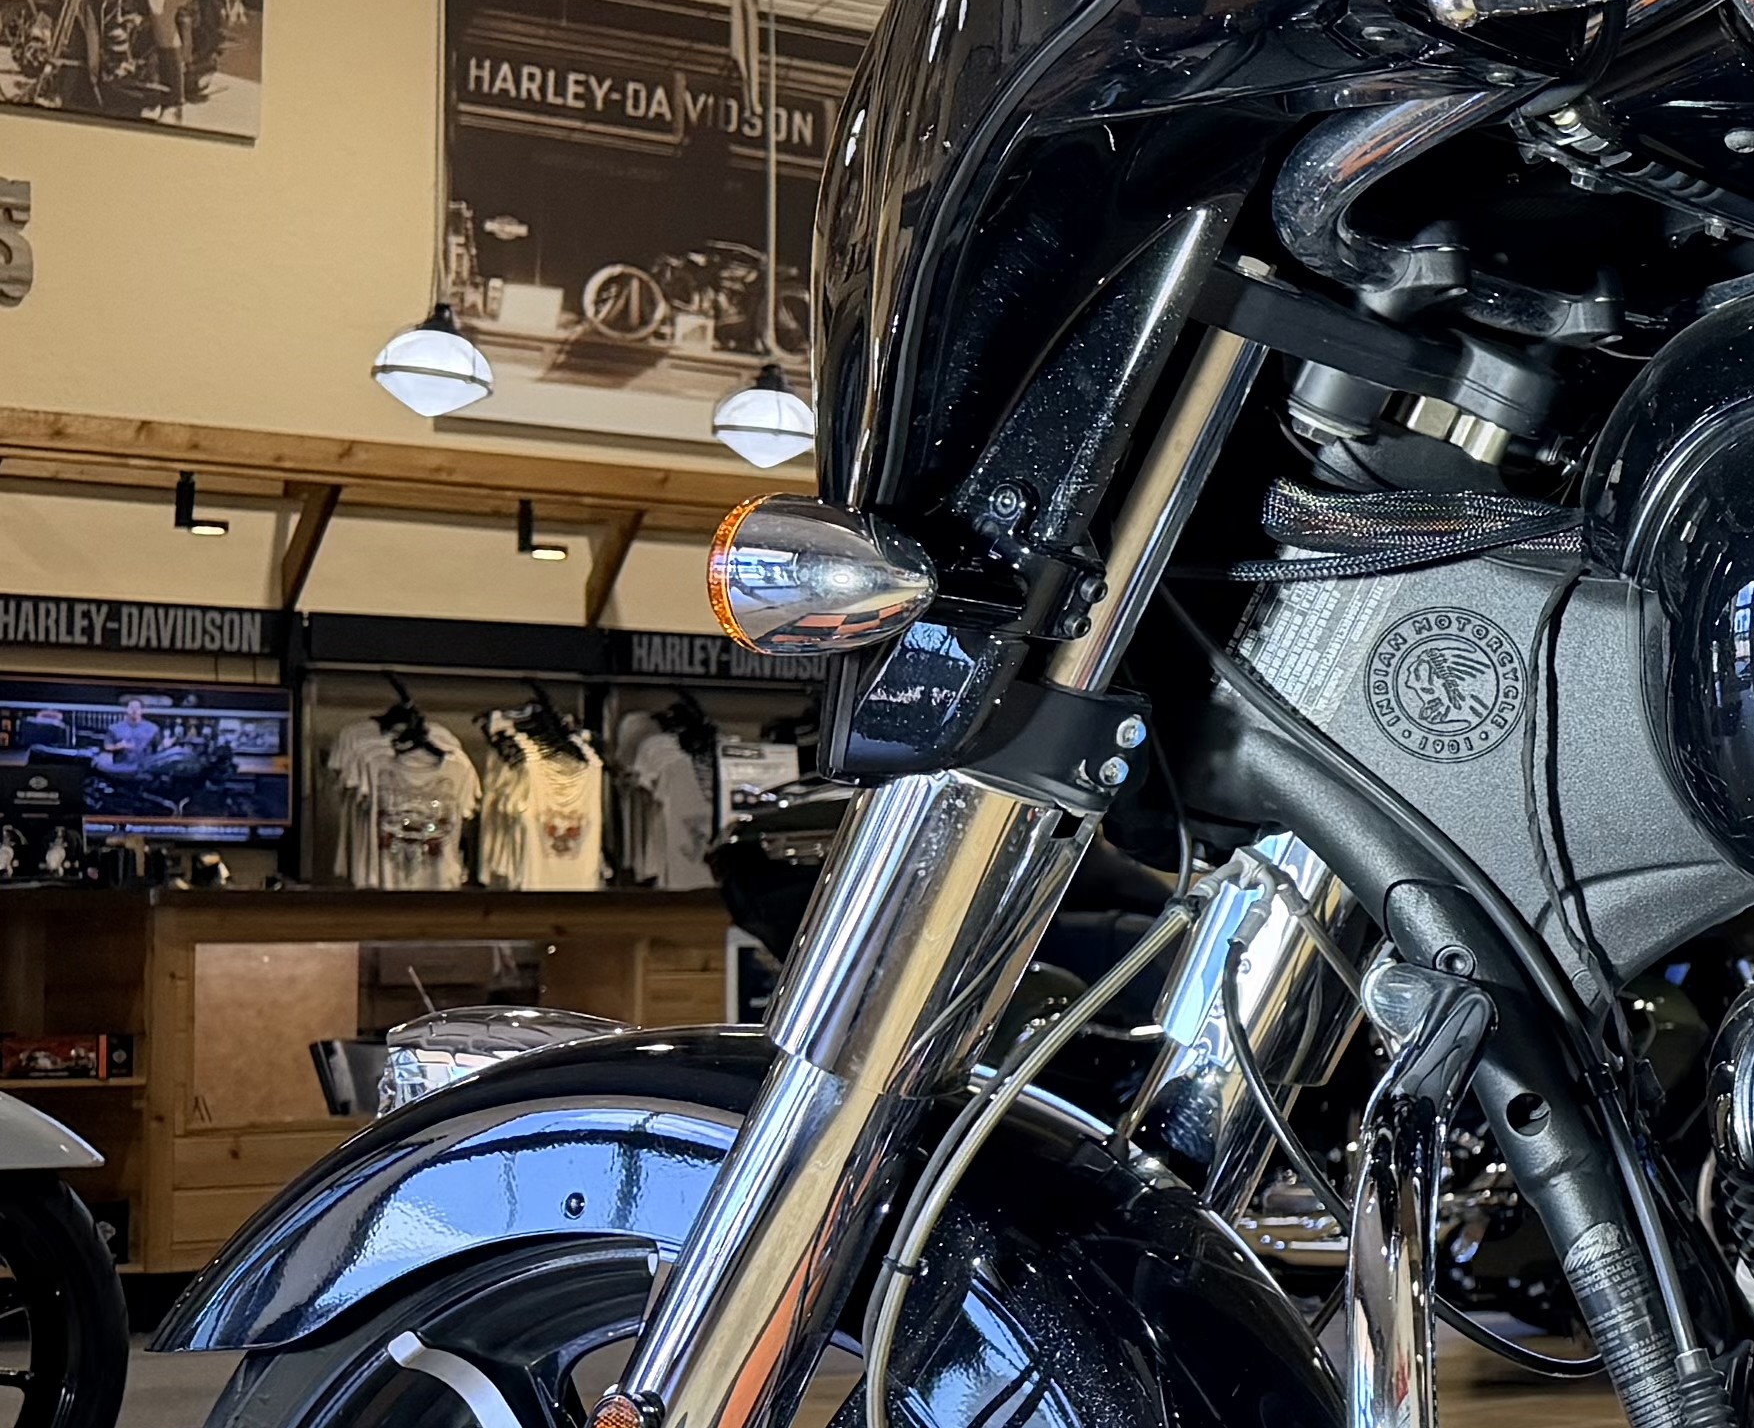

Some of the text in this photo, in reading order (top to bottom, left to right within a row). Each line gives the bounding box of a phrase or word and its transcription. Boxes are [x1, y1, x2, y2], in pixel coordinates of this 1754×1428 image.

[467, 57, 815, 148] HARLEY-DAVIDSON
[0, 599, 262, 654] HARLEY-DAVIDSON
[631, 634, 827, 682] HARLEY-DAVIDSO
[1371, 632, 1408, 729] INDIAN
[1412, 613, 1520, 730] MOTORCYCLE
[1417, 734, 1475, 755] 1901
